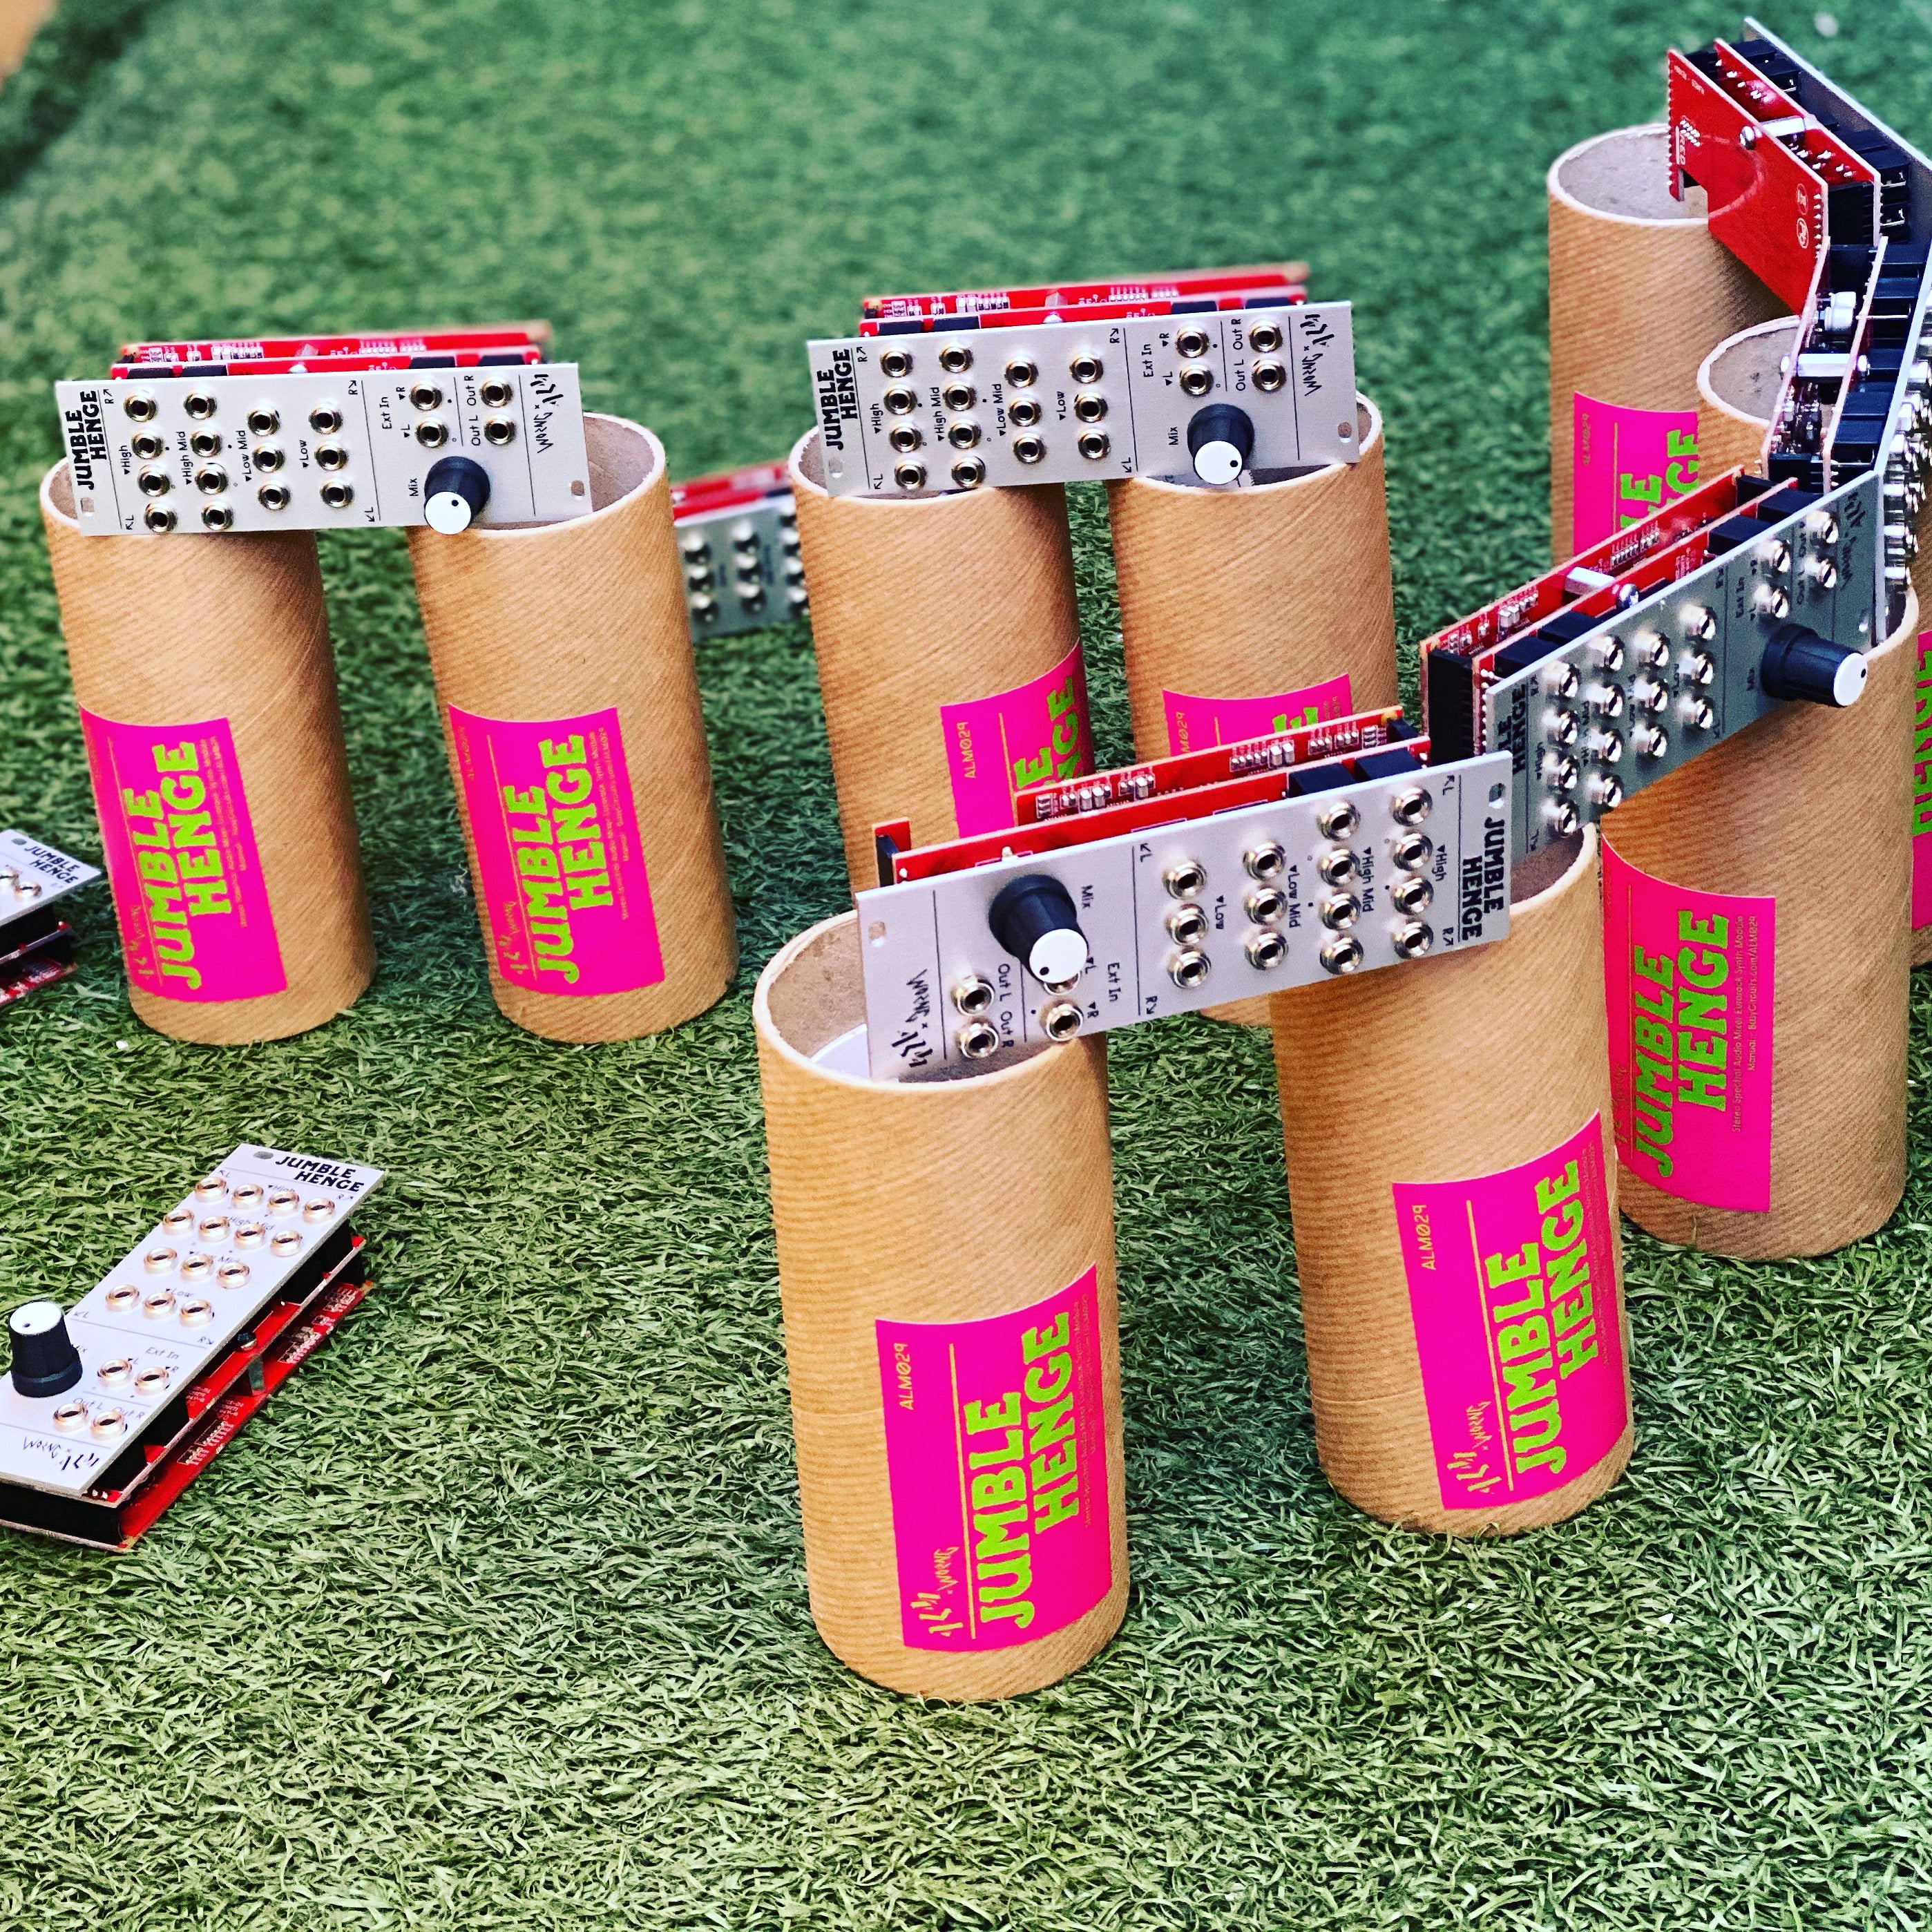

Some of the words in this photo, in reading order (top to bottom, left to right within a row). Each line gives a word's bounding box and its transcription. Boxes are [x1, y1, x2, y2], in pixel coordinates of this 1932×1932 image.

[1142, 344, 1152, 356] In
[1233, 328, 1243, 350] Out
[1143, 360, 1154, 377] Ext
[832, 349, 858, 419] HENGE
[992, 383, 1003, 403] Mid
[1235, 371, 1246, 391] Out
[380, 396, 390, 408] In
[466, 386, 477, 405] Out
[930, 387, 941, 406] Mid
[1057, 392, 1066, 412] Low
[381, 412, 392, 430] Ext
[817, 370, 844, 450] JUMBLE
[870, 403, 883, 425] High
[933, 411, 946, 433] High
[996, 408, 1006, 429] Low
[80, 390, 106, 459] HENGE
[470, 427, 481, 446] Out
[1168, 426, 1178, 446] Mix
[66, 410, 94, 490] JUMBLE
[176, 431, 187, 450] Mid
[236, 430, 247, 450] Mid
[300, 440, 309, 461] Low
[119, 446, 131, 468] High
[180, 455, 193, 477] High
[242, 454, 251, 475] Low
[408, 478, 419, 497] Mix
[1175, 711, 1190, 754] M029
[957, 722, 976, 778] ALM029
[151, 741, 231, 915] HENGE
[539, 734, 614, 910] HENGE
[24, 845, 80, 872] JUMBLE
[1361, 855, 1374, 883] High
[1432, 853, 1448, 882] High
[1484, 816, 1504, 914] JUMBLE
[30, 859, 78, 883] HENGE
[124, 787, 202, 990] JUMBLE
[503, 785, 580, 984] JUMBLE
[1082, 885, 1094, 908] Mix
[1288, 871, 1300, 899] Low
[1363, 887, 1374, 912] Mid
[1462, 856, 1482, 941] HENGE
[1214, 903, 1226, 929] Low
[1289, 903, 1301, 928] Mid
[1108, 962, 1120, 984] Ext
[1734, 951, 1745, 974] Synth
[997, 964, 1011, 989] Out
[1000, 993, 1012, 1002] L
[1109, 987, 1121, 1002] In
[1677, 910, 1730, 1111] HENGE
[1001, 1011, 1014, 1037] Out
[1733, 1017, 1742, 1040] Mixer
[1634, 945, 1674, 1178] JUMBLE
[1732, 1042, 1742, 1066] Audio
[1748, 1040, 1756, 1071] Manual
[276, 1156, 356, 1178] JUMBLE
[294, 1171, 364, 1192] HENGE
[1413, 1205, 1437, 1270] ALM029
[1535, 1159, 1599, 1379] HENGE
[145, 1346, 165, 1357] Ext
[166, 1351, 180, 1359] In
[1484, 1242, 1567, 1475] JUMBLE
[894, 1342, 915, 1410] ALM029
[1022, 1312, 1080, 1535] HENGE
[964, 1391, 1035, 1629] JUMBLE
